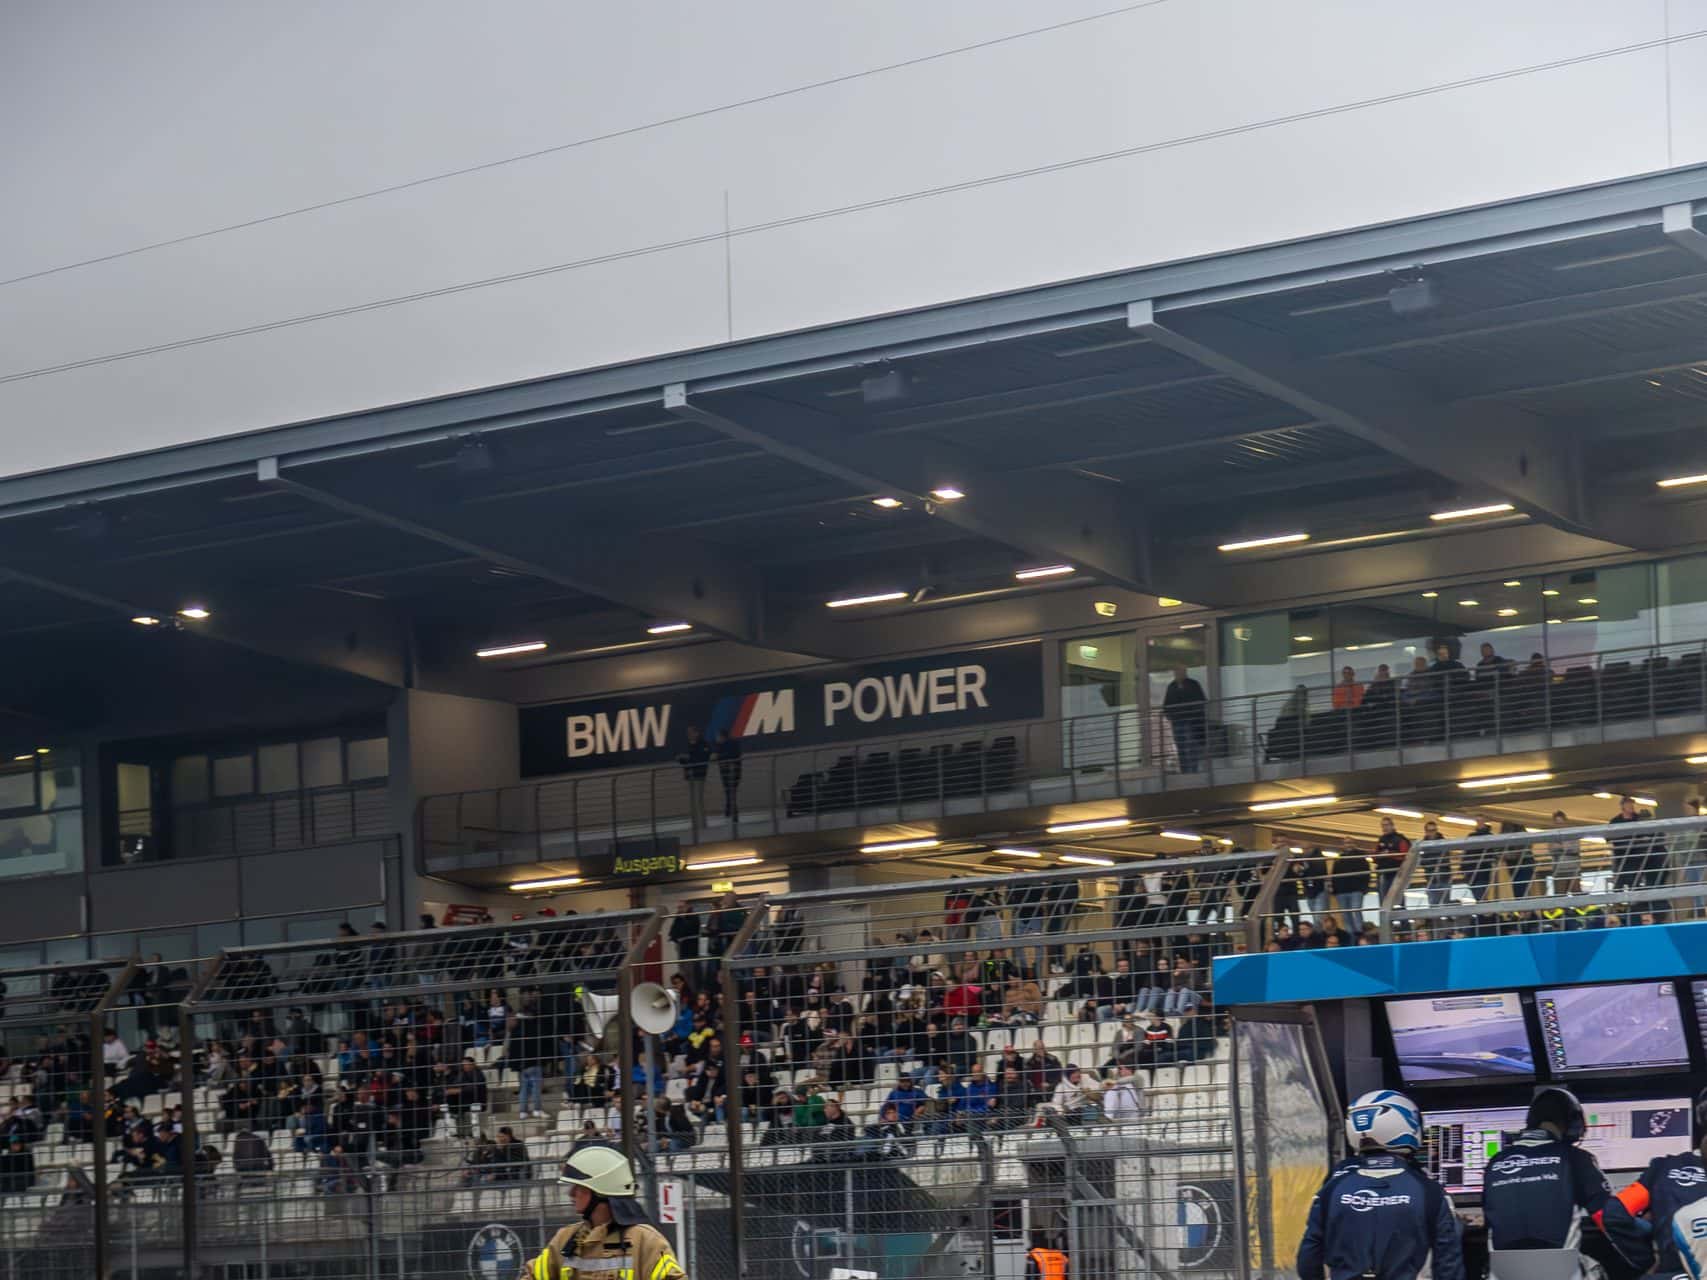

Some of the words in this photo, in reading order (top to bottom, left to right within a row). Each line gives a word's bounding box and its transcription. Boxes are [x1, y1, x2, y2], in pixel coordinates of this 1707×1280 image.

[566, 704, 671, 758] BMW
[824, 664, 989, 727] POWER
[615, 855, 676, 876] Ausgang
[1340, 1191, 1411, 1209] SCHERER
